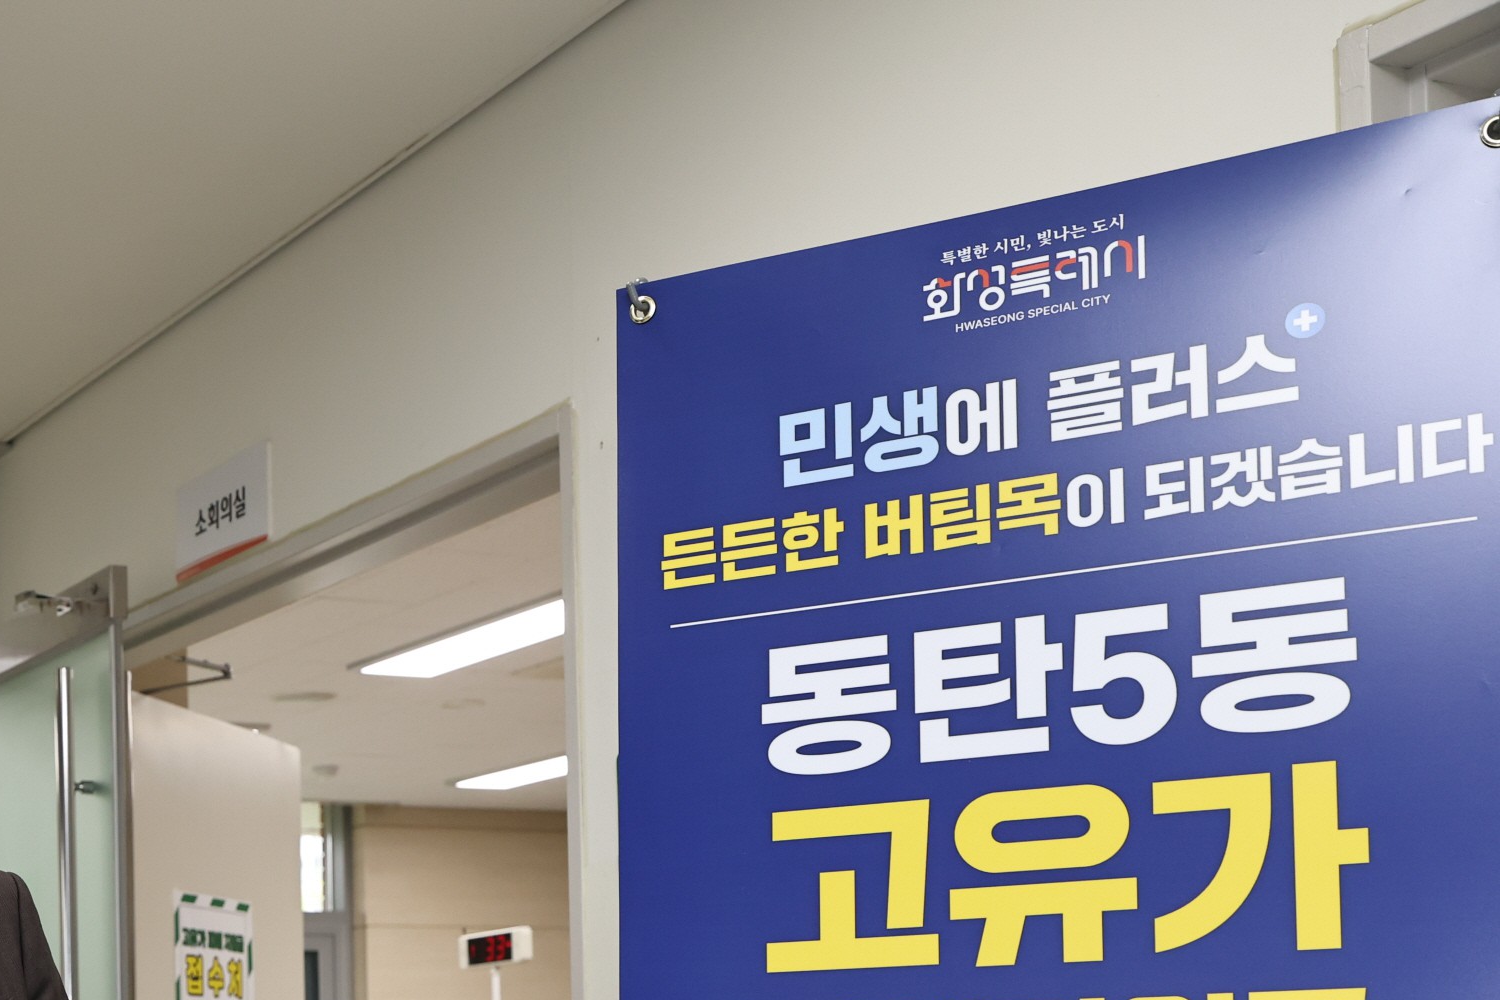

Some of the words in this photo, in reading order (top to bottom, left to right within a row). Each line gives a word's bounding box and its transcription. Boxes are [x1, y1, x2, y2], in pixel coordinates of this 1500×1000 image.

[923, 235, 1145, 321] 화성특례시
[941, 243, 989, 265] 특별한
[994, 235, 1031, 254] 시민,
[1037, 225, 1086, 246] 빛나는
[1092, 214, 1123, 233] 도시
[956, 311, 1024, 332] HWASEONG
[1028, 301, 1078, 318] SPECIAL
[1082, 294, 1110, 307] CITY
[780, 379, 1017, 487] 민생에
[1048, 334, 1299, 441] 플러스
[196, 486, 245, 536] 소회의실
[661, 508, 844, 590] 든든한
[865, 468, 1124, 558] 버팀목이
[1145, 413, 1493, 519] 되겠습니다
[762, 577, 1357, 774] 동탄5동
[766, 760, 1370, 973] 고유가
